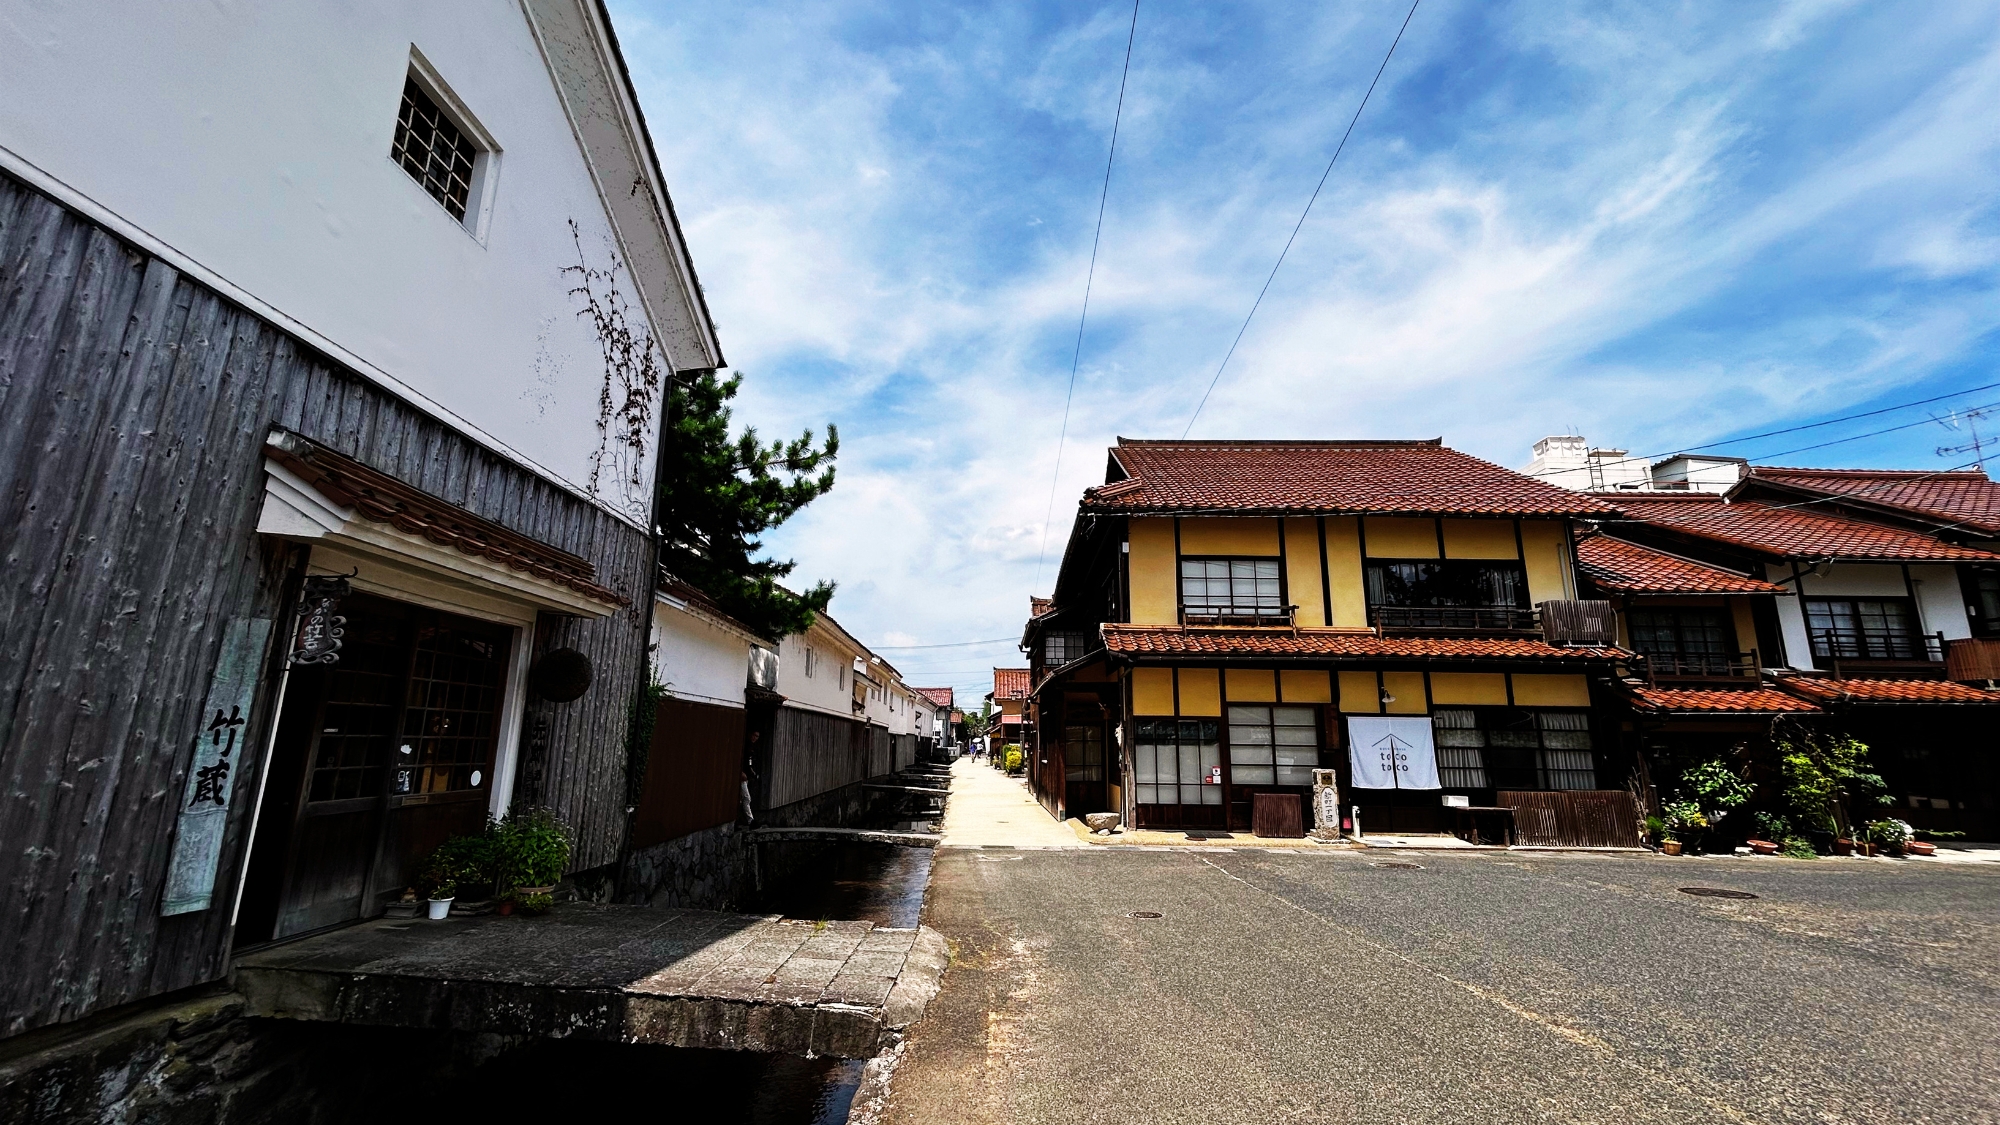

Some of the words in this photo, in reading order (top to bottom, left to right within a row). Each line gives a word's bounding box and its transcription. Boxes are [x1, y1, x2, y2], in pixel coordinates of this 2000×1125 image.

[189, 705, 246, 808] 竹蔵
[1380, 752, 1407, 761] toco
[1381, 763, 1409, 772] toco
